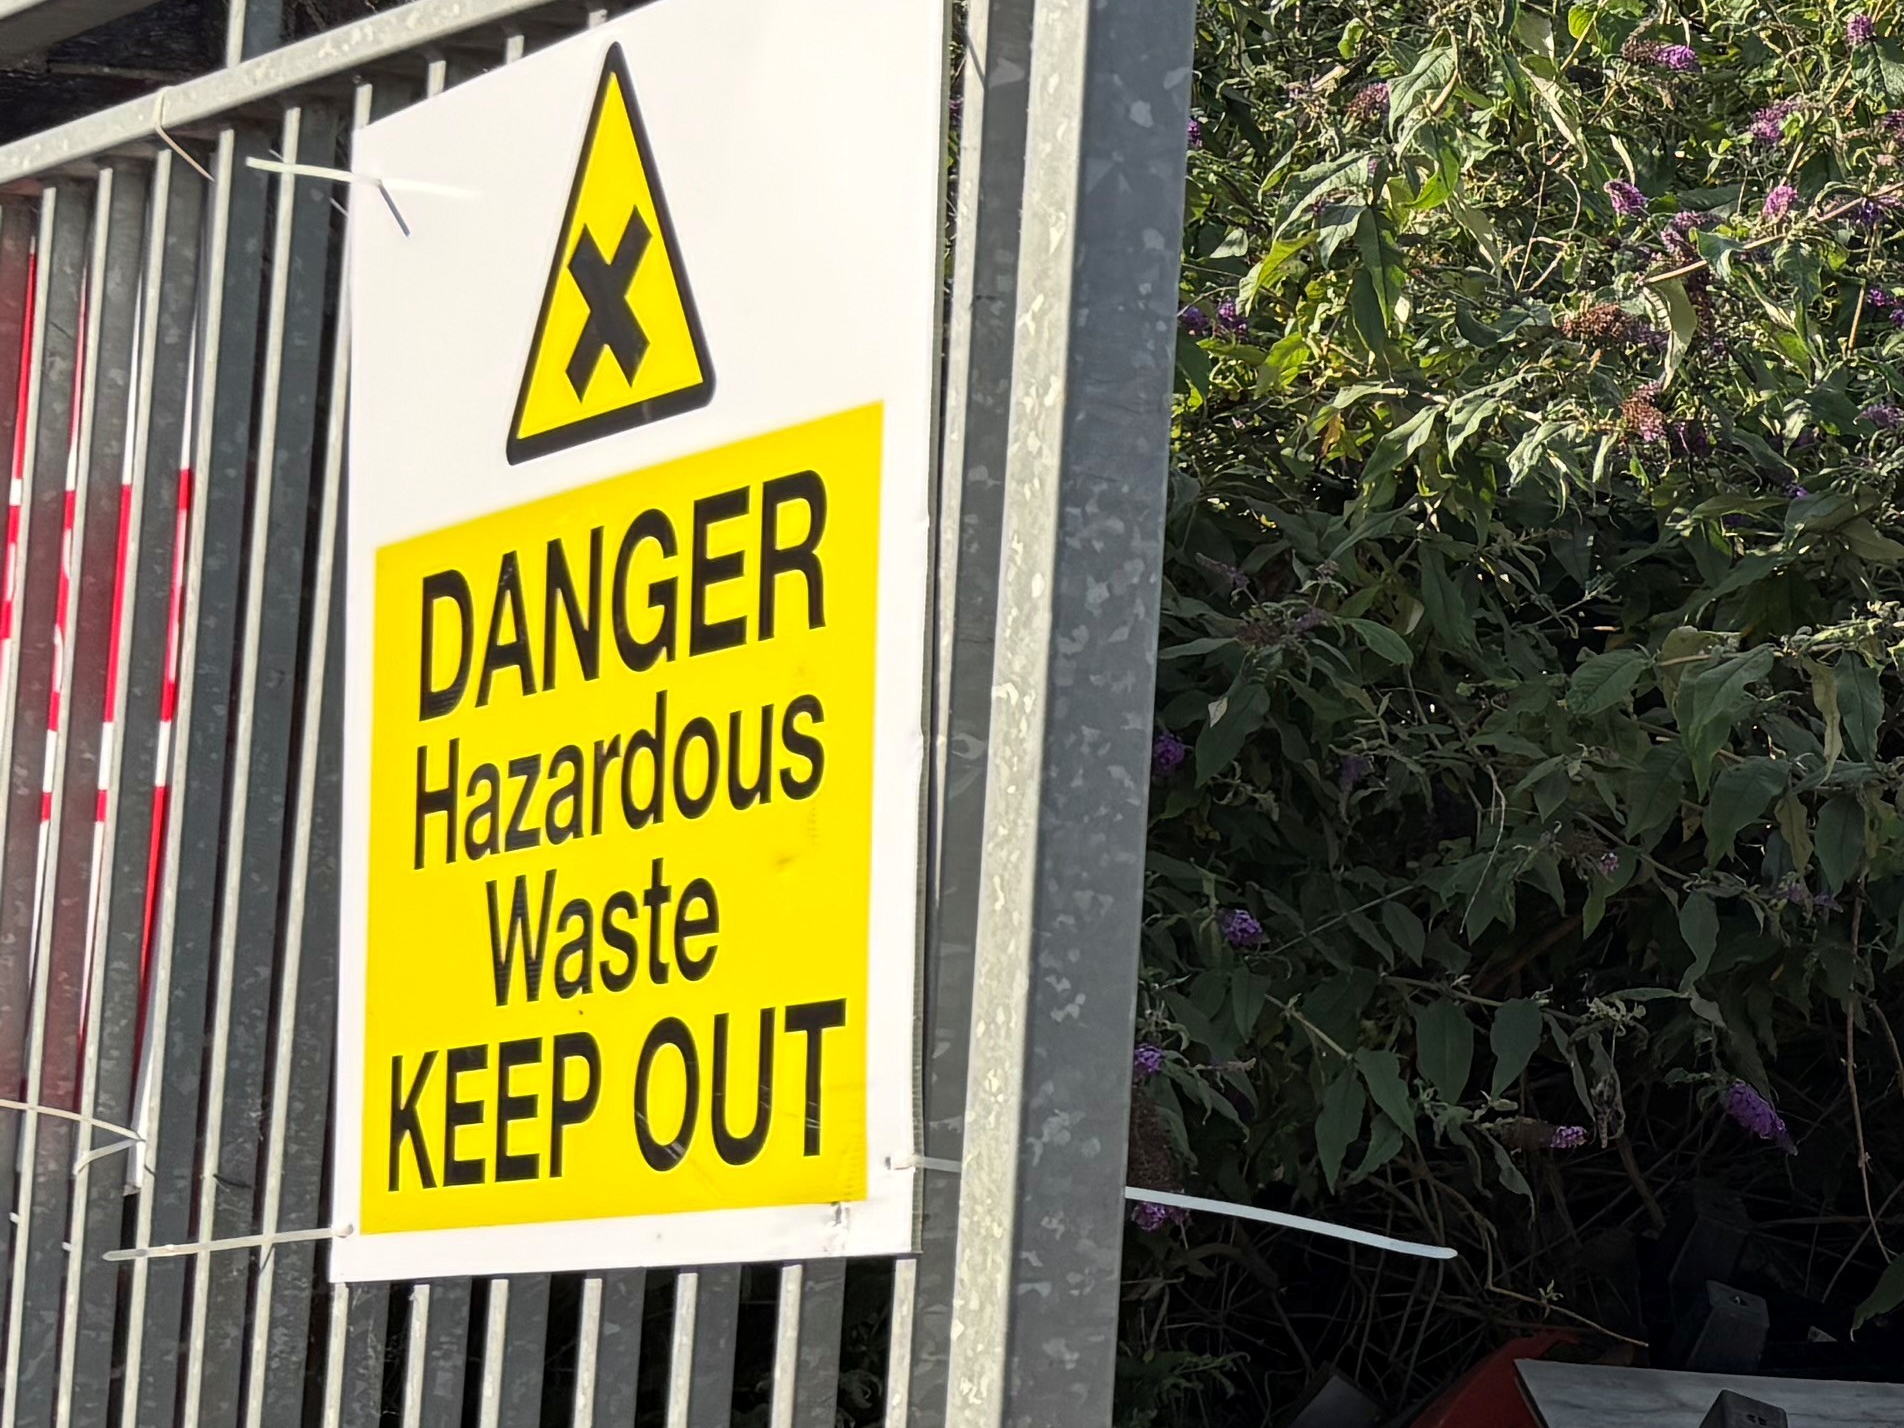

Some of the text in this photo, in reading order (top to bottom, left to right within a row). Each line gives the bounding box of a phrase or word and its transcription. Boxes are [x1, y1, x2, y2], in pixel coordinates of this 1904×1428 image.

[418, 469, 827, 723] DANGER
[413, 690, 825, 871] Hazardous
[485, 858, 720, 1008] Waste
[387, 997, 847, 1193] KEEP OUT
